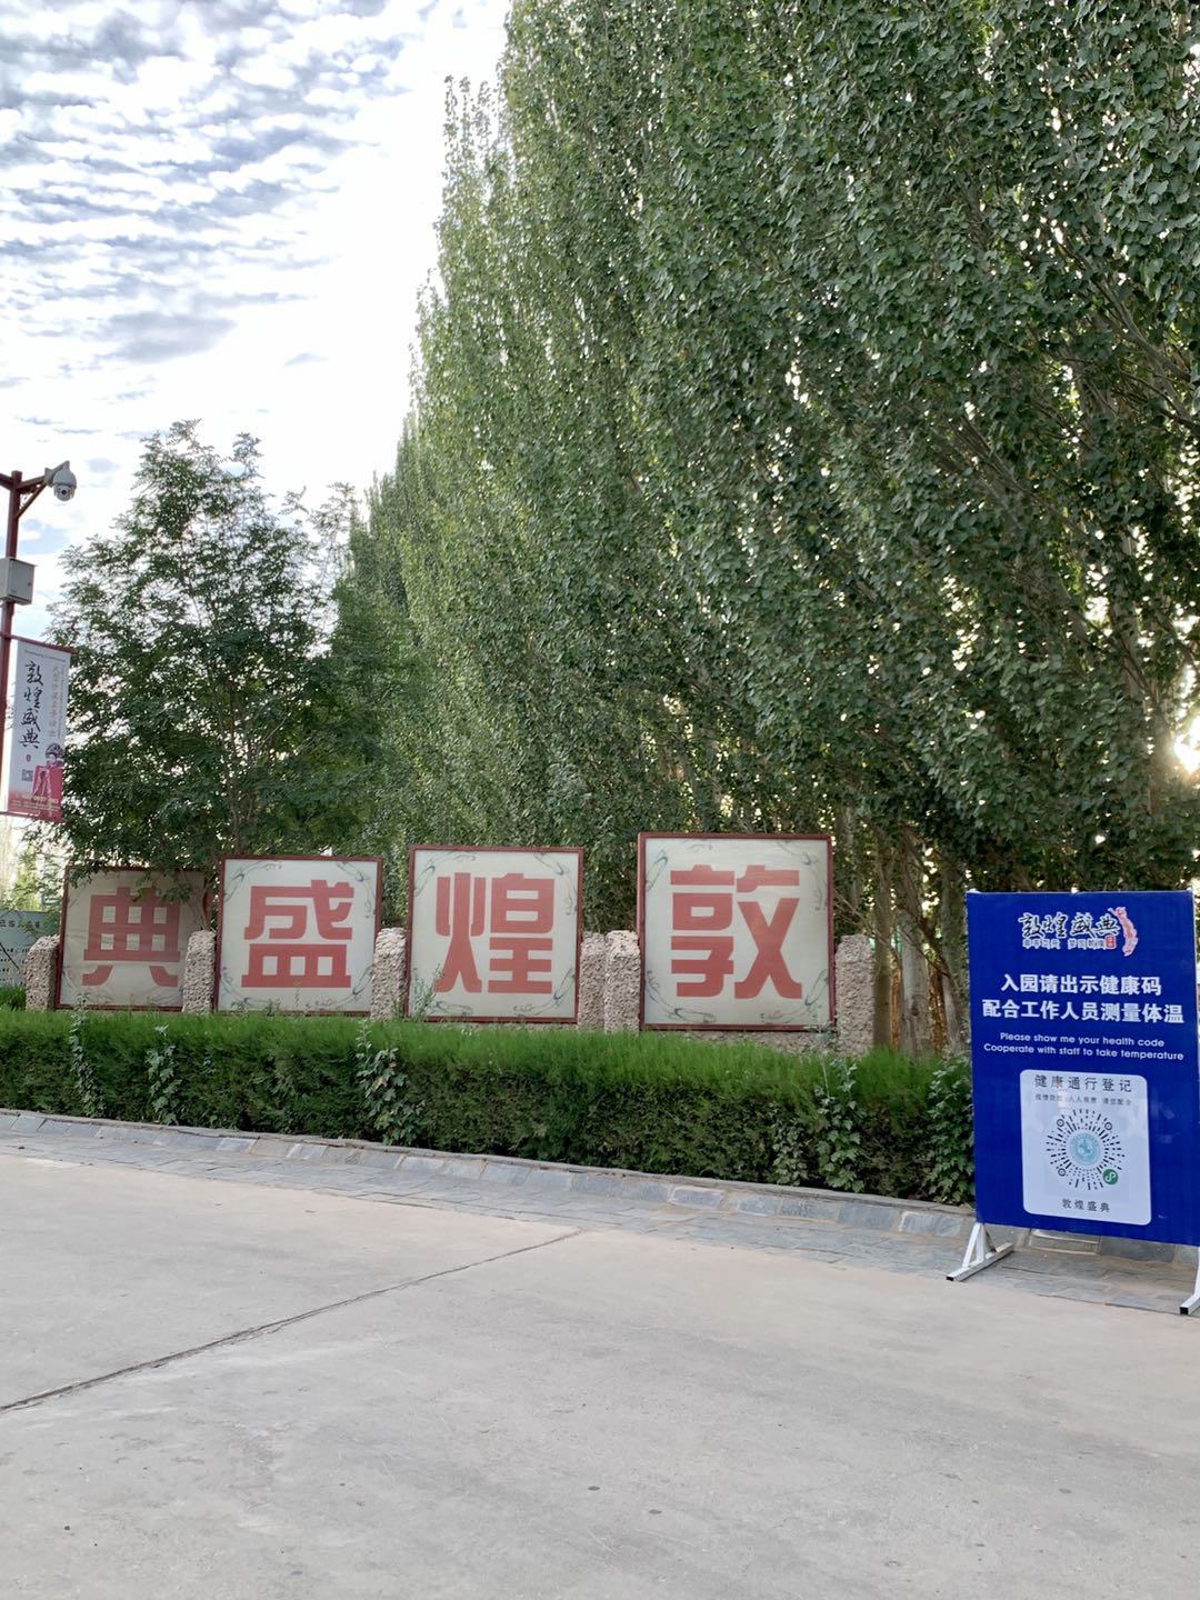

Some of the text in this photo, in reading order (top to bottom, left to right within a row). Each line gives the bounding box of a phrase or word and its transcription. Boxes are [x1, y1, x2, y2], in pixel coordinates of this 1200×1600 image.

[18, 660, 44, 749] 敦煌盛典
[82, 886, 181, 987] 典
[241, 879, 354, 988] 盛
[434, 871, 555, 994] 煌
[669, 864, 803, 1000] 敦
[1018, 911, 1121, 938] 敦煌盛典
[1001, 973, 1162, 996] 入园请出示健康码
[982, 999, 1184, 1024] 配合工作人员测量体温
[983, 1043, 1185, 1062] Cooperate with staff to take temperature
[1000, 1032, 1165, 1048] Please show me your health code
[1034, 1074, 1133, 1093] 健康通行登记
[1062, 1198, 1111, 1213] 敦煌盛典
